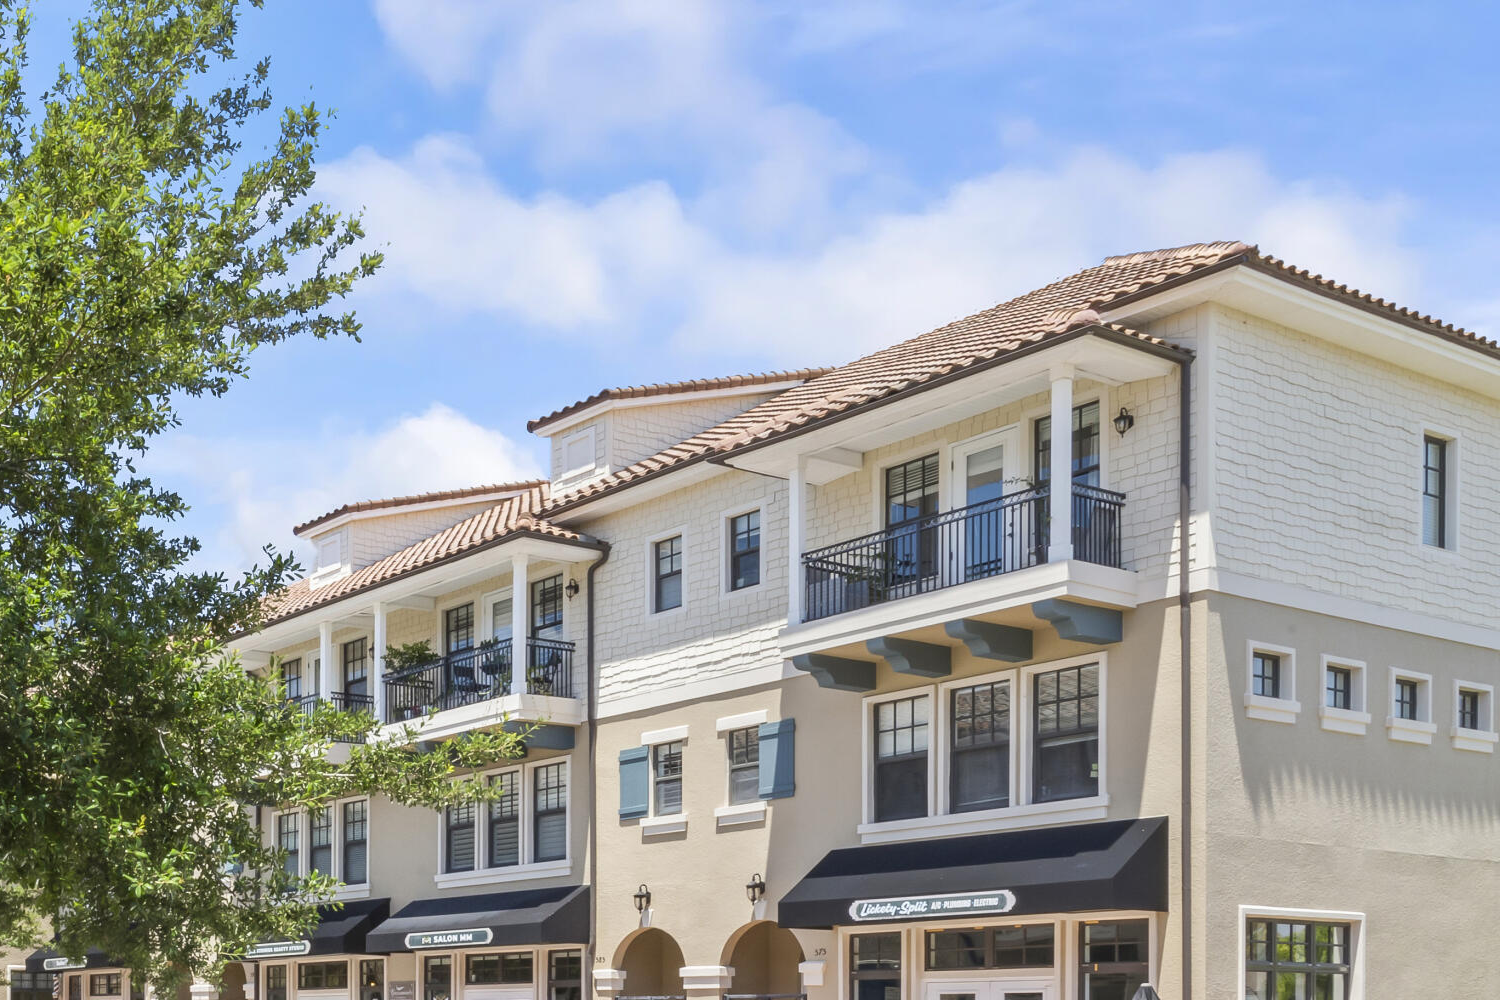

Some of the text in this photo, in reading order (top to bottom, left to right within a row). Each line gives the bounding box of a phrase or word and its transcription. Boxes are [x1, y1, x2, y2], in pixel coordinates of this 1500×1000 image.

[861, 901, 928, 917] Lickety-Split
[433, 934, 458, 943] SALON
[459, 933, 473, 942] MM
